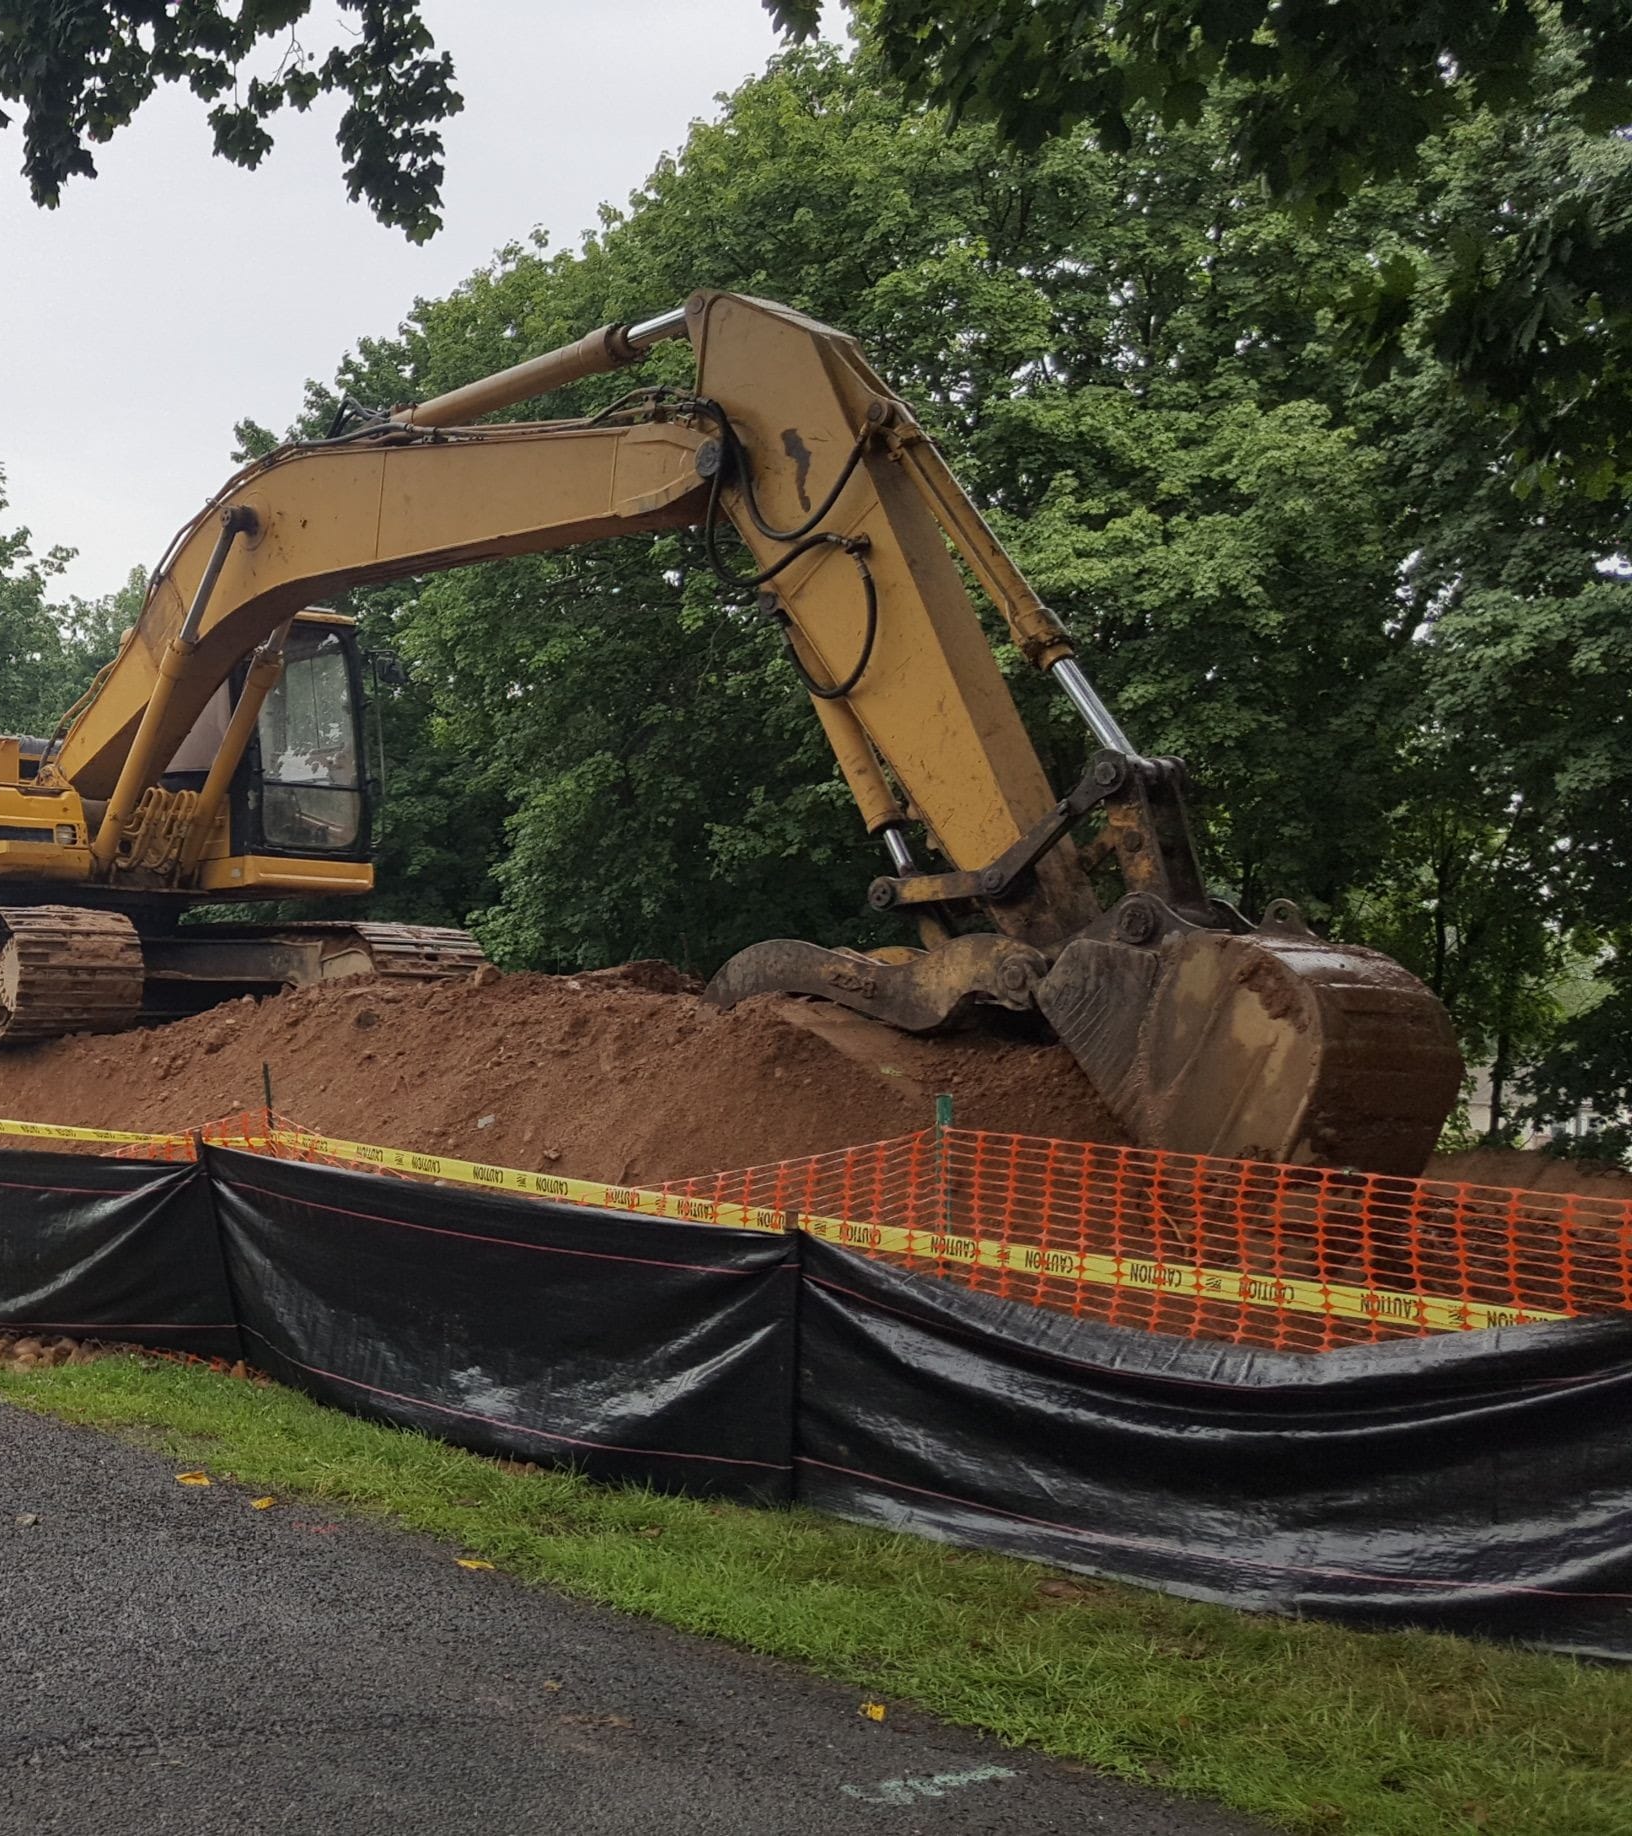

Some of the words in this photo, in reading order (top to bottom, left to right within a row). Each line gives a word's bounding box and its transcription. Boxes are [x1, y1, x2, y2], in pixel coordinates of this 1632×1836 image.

[412, 1155, 441, 1174] CAUTION
[472, 1166, 504, 1184] CAUTION
[535, 1176, 569, 1196] CAUTION
[838, 1225, 882, 1246] CUTIO
